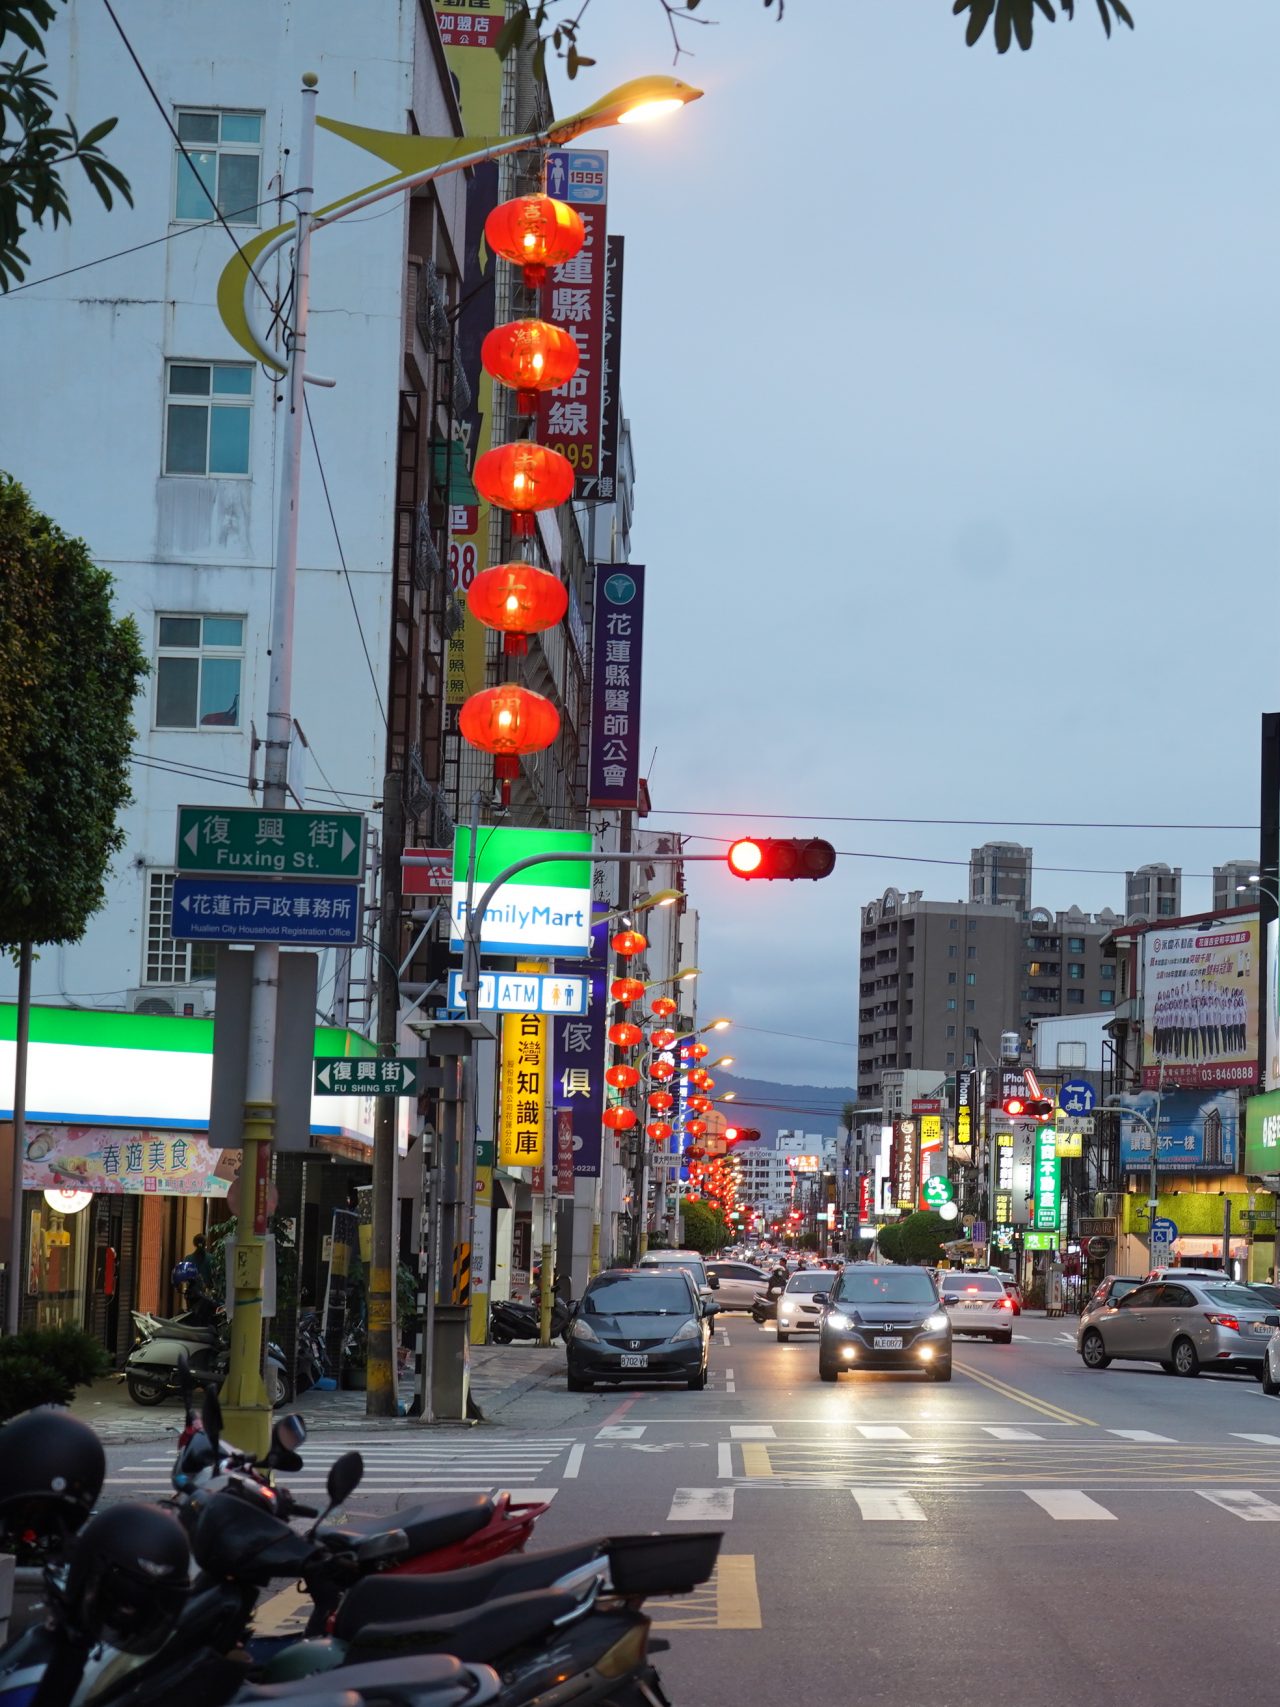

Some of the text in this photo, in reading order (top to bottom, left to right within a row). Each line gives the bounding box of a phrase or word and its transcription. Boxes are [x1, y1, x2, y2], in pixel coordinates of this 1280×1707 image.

[440, 15, 490, 32] 加盟店
[570, 171, 603, 184] 1995
[602, 613, 631, 788] 花蓮縣醫師公會
[202, 815, 338, 848] 復興街
[216, 849, 320, 870] Fuxing St.
[192, 893, 351, 920] 花蓮市戶政事務所
[457, 901, 584, 930] FmilyMart
[190, 924, 351, 937] Hualien City Household Registration Office
[502, 984, 535, 1003] ATM
[333, 1062, 400, 1081] 復興街
[1202, 1066, 1253, 1081] 03-8460888
[334, 1084, 346, 1092] FU
[351, 1084, 380, 1092] SHING
[515, 1014, 541, 1155] 台灣知識庫
[959, 1073, 970, 1105] iPhone
[102, 1138, 189, 1175] 春遊美食
[1040, 1129, 1056, 1207] 住商不動產
[1083, 1221, 1113, 1234] BAR
